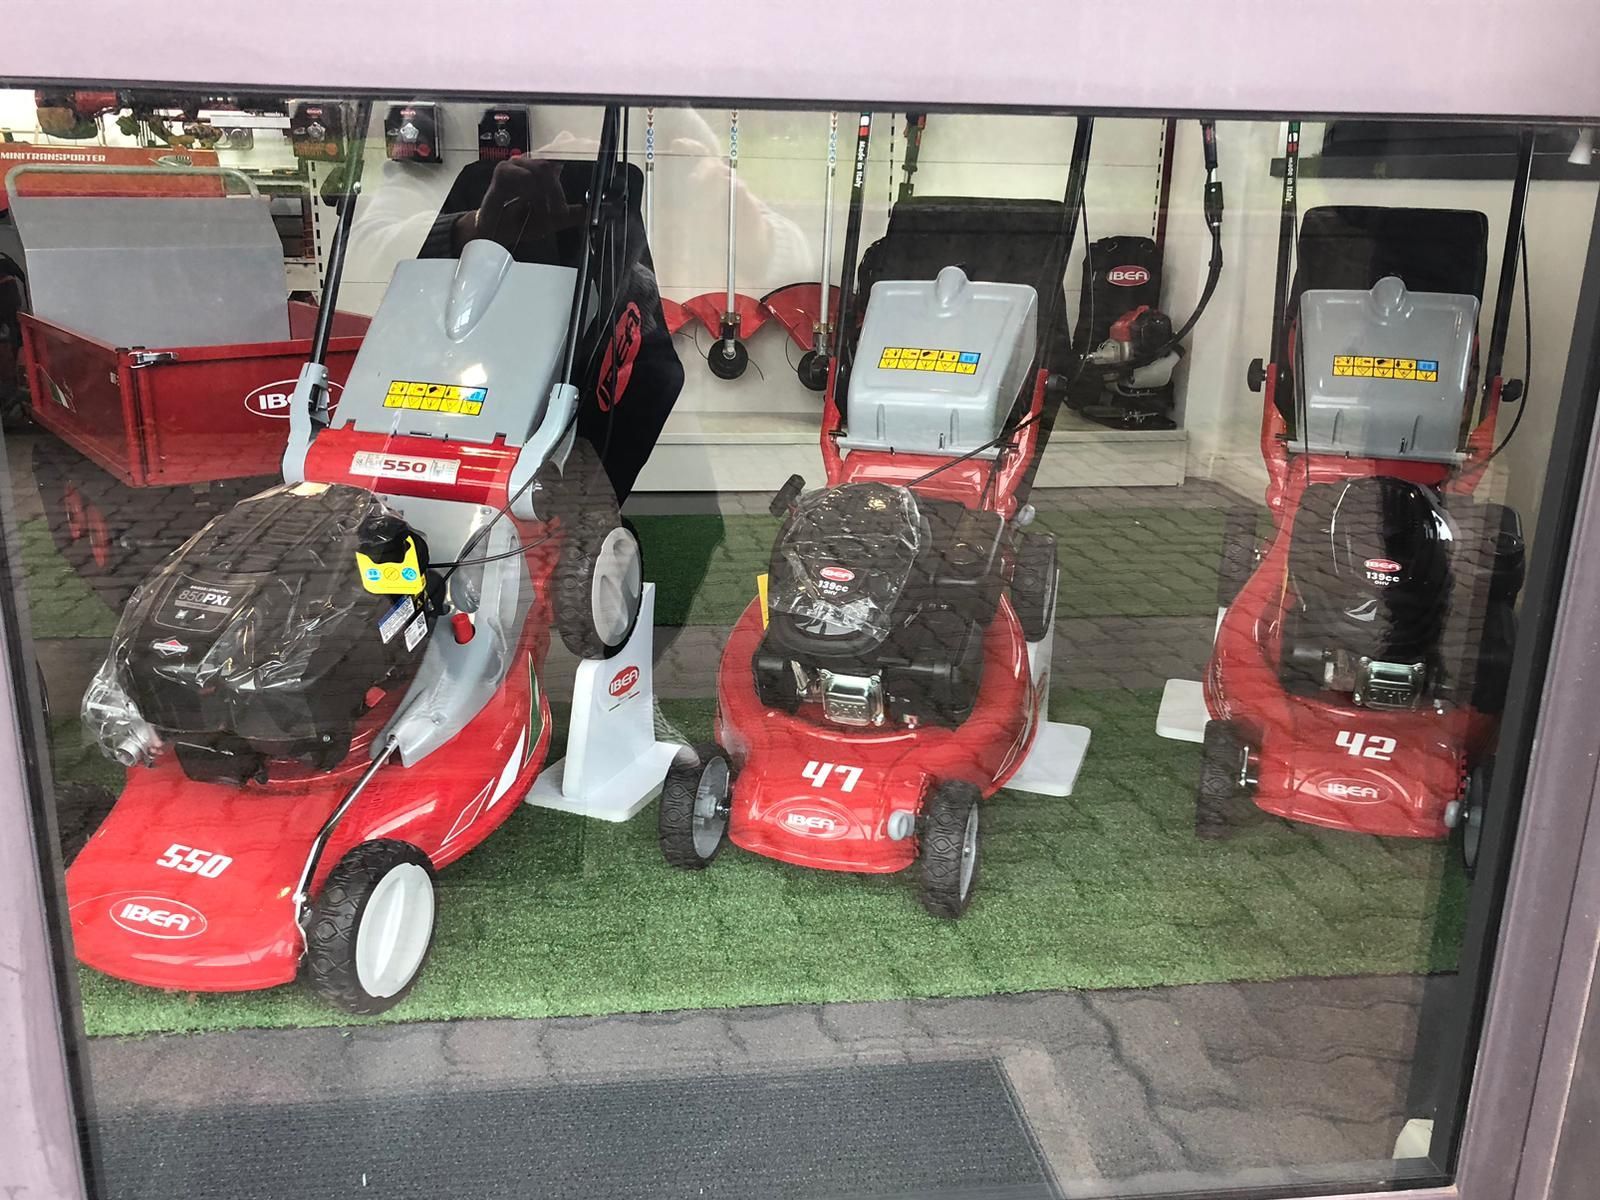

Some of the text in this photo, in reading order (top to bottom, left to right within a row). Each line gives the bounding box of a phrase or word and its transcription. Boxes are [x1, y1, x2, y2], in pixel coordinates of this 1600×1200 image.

[0, 151, 106, 162] MINITRANSPORTER
[1108, 271, 1149, 281] IBEA
[382, 459, 427, 474] 550
[1366, 571, 1400, 582] 139cc
[818, 580, 849, 592] 139cc
[178, 589, 232, 606] 850PXi
[610, 669, 639, 695] IBEA
[1335, 730, 1397, 761] 42
[801, 760, 864, 793] 47
[1327, 783, 1379, 799] IBEA
[785, 813, 836, 831] IBEA
[156, 843, 233, 879] 550
[119, 903, 192, 931] IBEA
